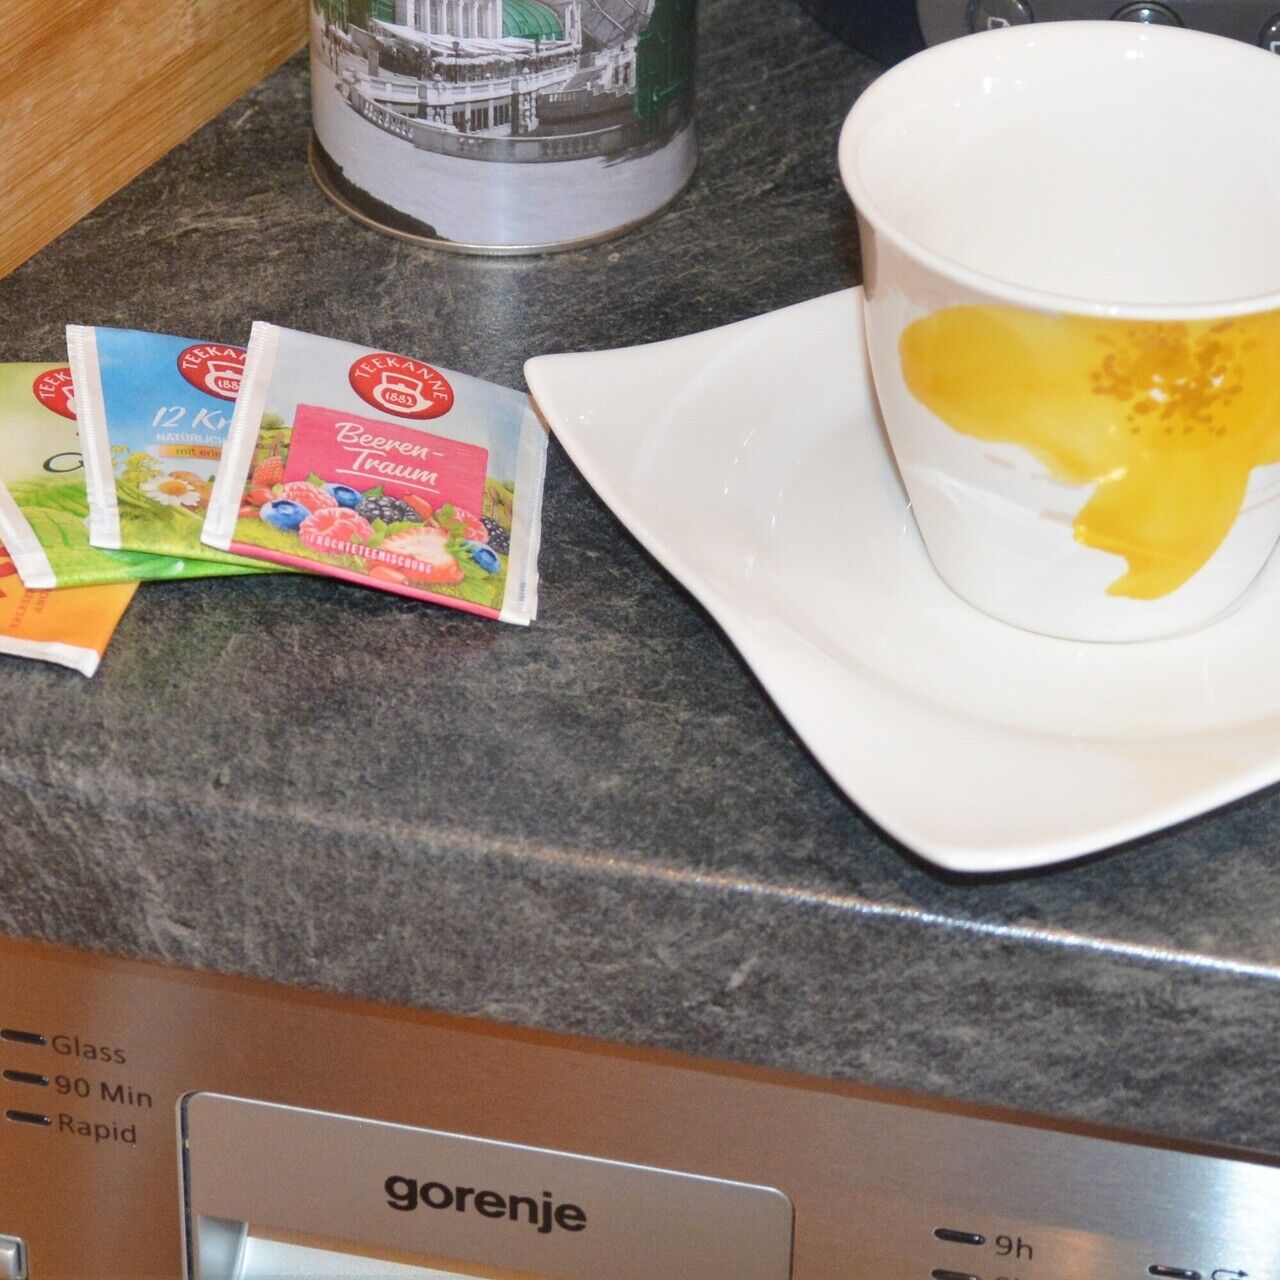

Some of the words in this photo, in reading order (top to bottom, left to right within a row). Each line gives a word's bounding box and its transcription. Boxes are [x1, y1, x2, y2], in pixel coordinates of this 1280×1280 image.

[218, 379, 240, 390] 188
[355, 357, 448, 401] TEEKANNE
[386, 392, 414, 406] 1882
[152, 406, 185, 428] 12
[343, 446, 438, 485] Traum
[52, 1035, 126, 1064] Glass
[55, 1075, 90, 1098] 90
[101, 1082, 152, 1108] Min
[59, 1113, 136, 1143] Rapid
[385, 1175, 587, 1233] gorenje
[996, 1235, 1032, 1260] 9h
